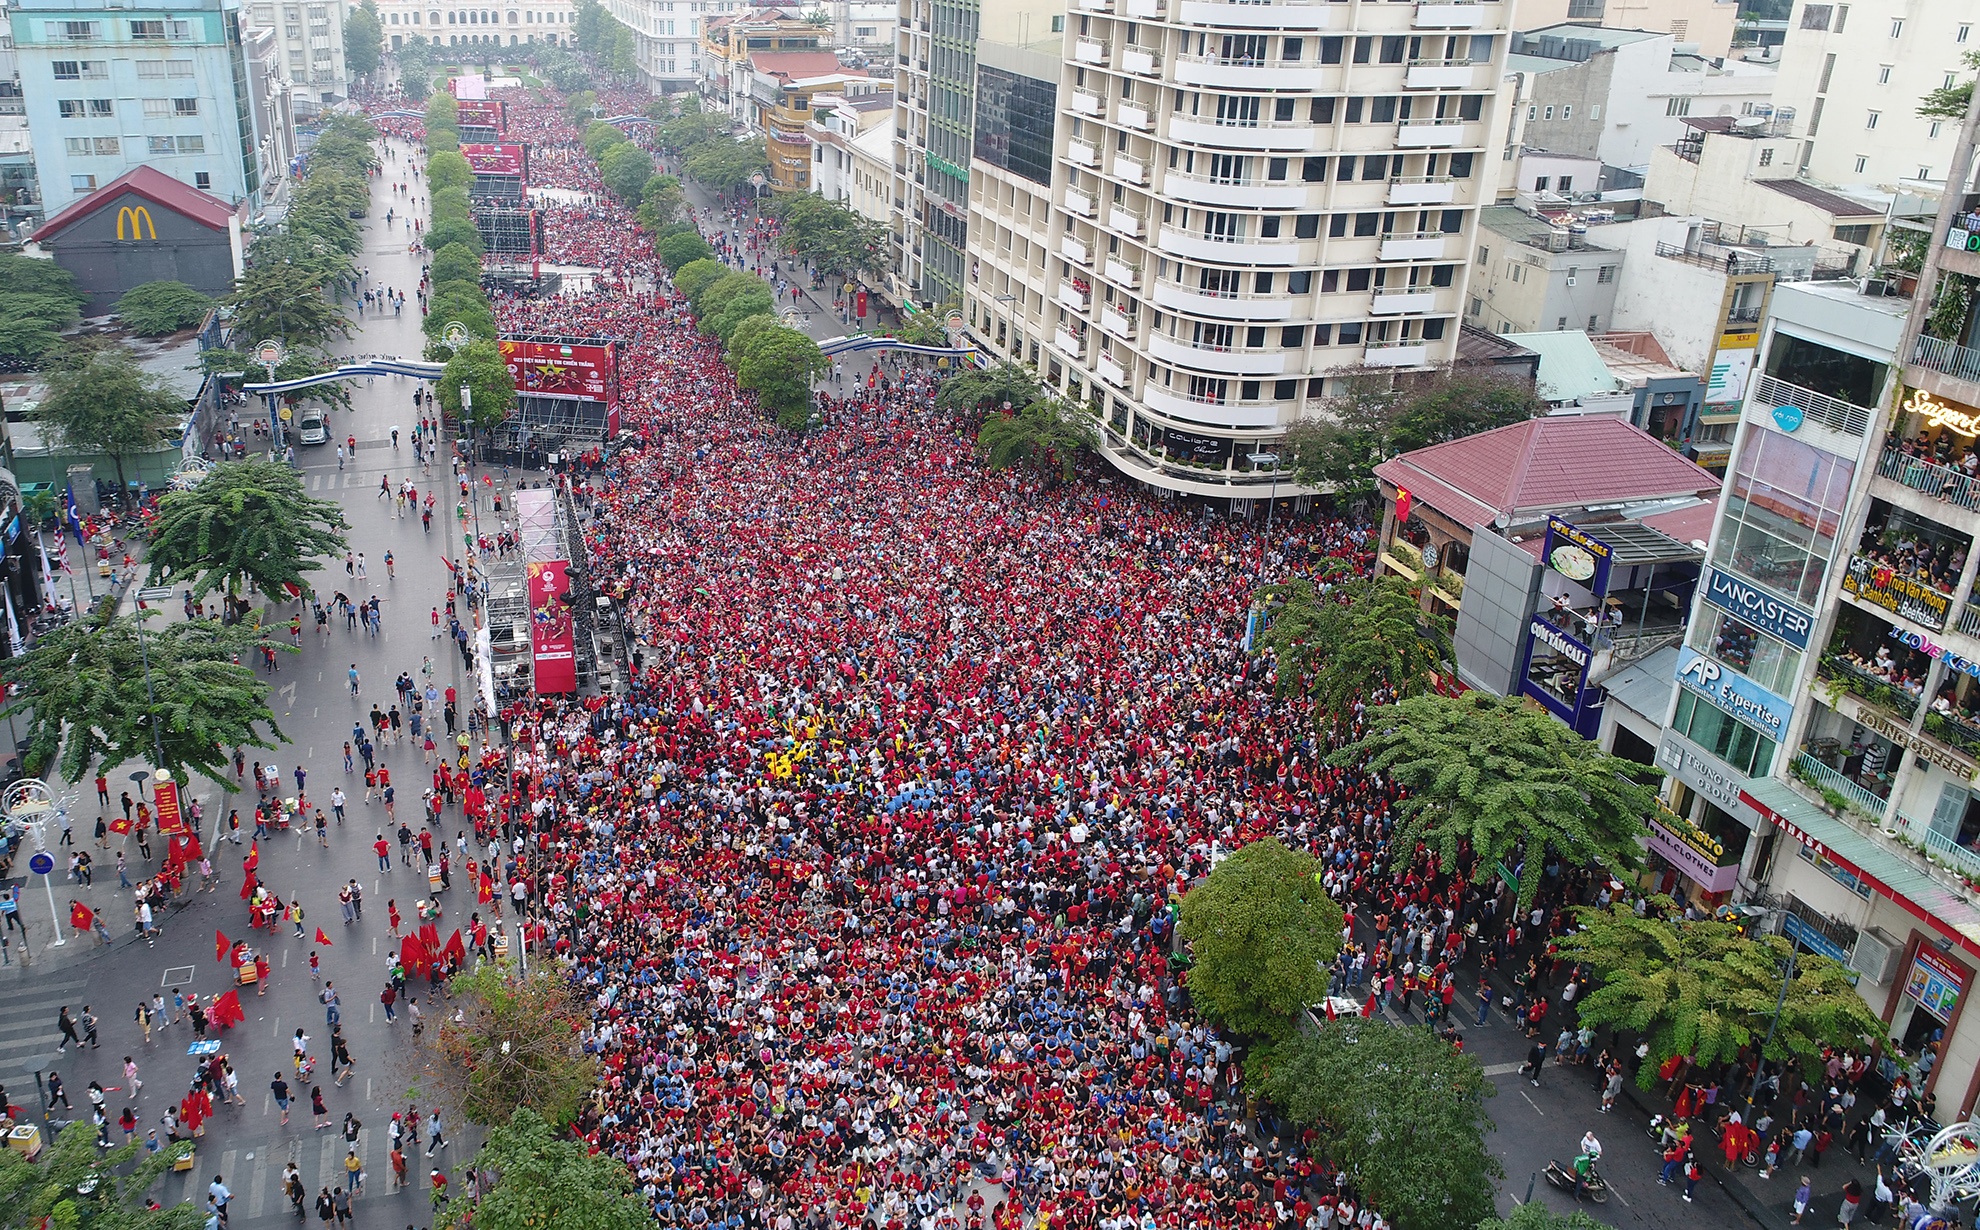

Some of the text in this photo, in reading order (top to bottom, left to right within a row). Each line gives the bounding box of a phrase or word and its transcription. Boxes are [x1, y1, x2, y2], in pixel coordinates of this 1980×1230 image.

[1713, 574, 1809, 636] LANCASTER
[1728, 602, 1784, 635] LINCOLN
[1899, 630, 1946, 659] LOVE
[1679, 675, 1717, 704] Accounting
[1737, 709, 1778, 739] Consulting
[1720, 682, 1781, 729] Expertise
[1856, 706, 1972, 783] YOUNG COFFEE
[1686, 752, 1723, 785] TRUNG
[1697, 777, 1737, 808] GROUP
[1770, 811, 1823, 855] FAHASA
